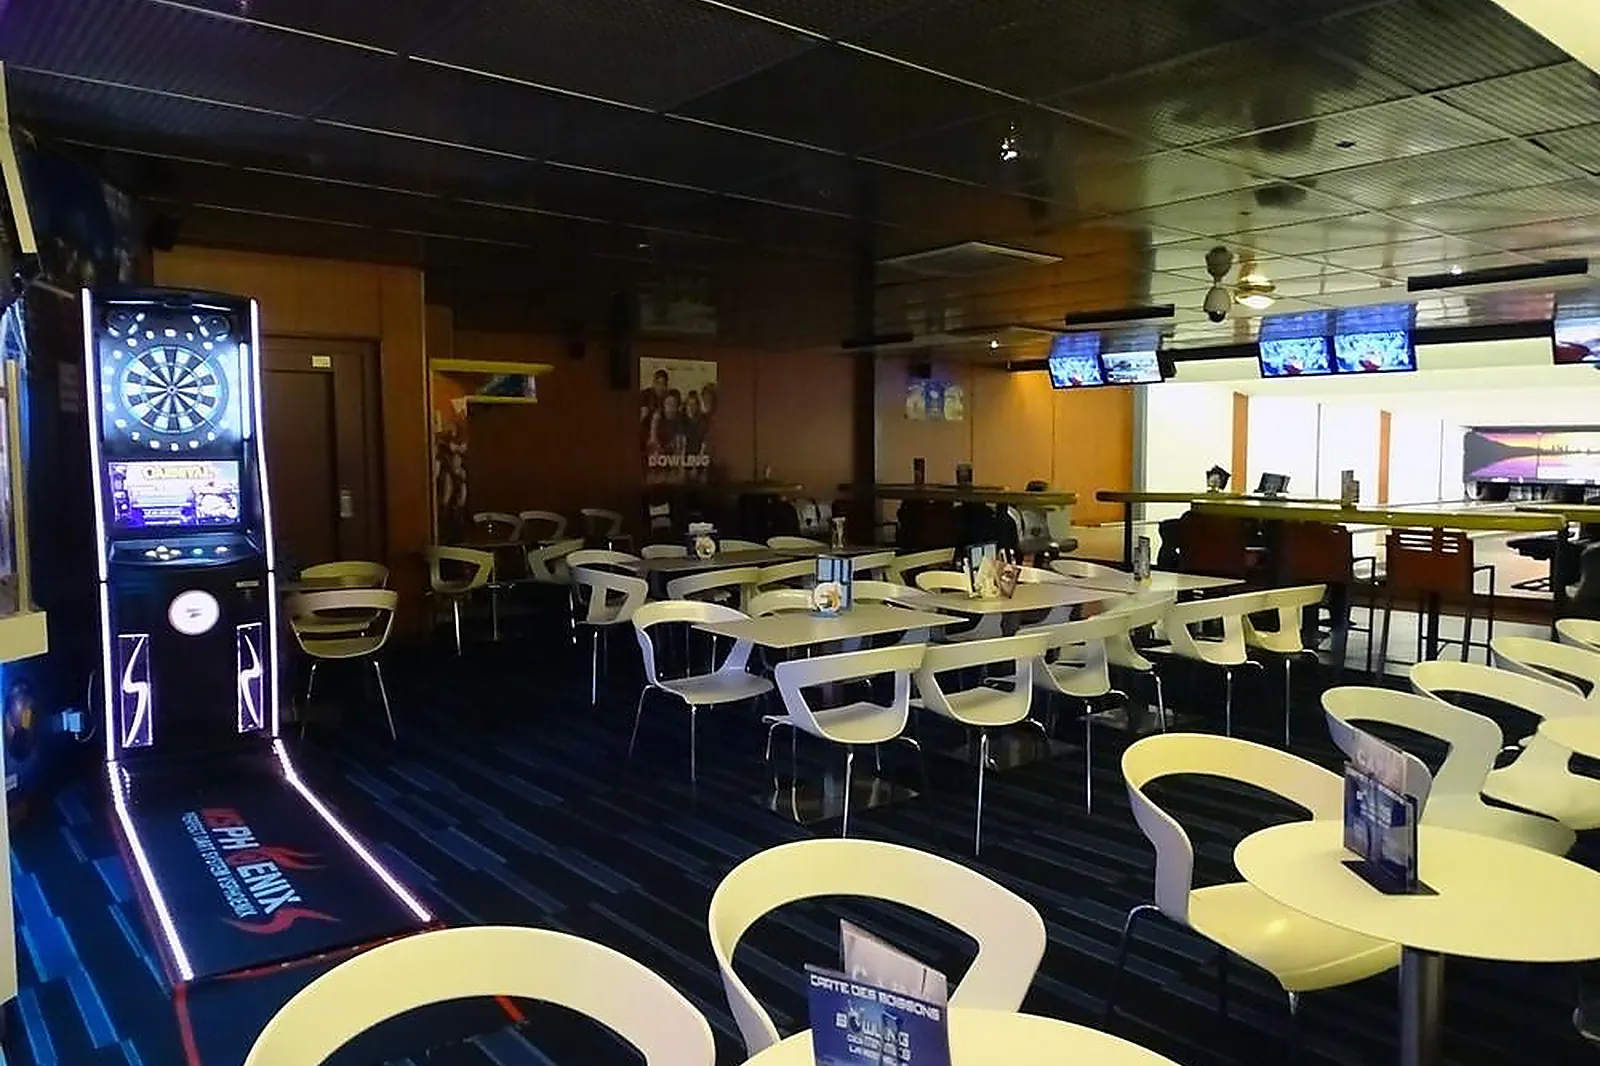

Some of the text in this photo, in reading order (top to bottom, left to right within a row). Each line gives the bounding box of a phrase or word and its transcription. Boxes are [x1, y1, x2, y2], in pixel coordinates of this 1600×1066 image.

[648, 455, 711, 468] BOWLING
[810, 974, 940, 1021] CARTE DES BOISSONS
